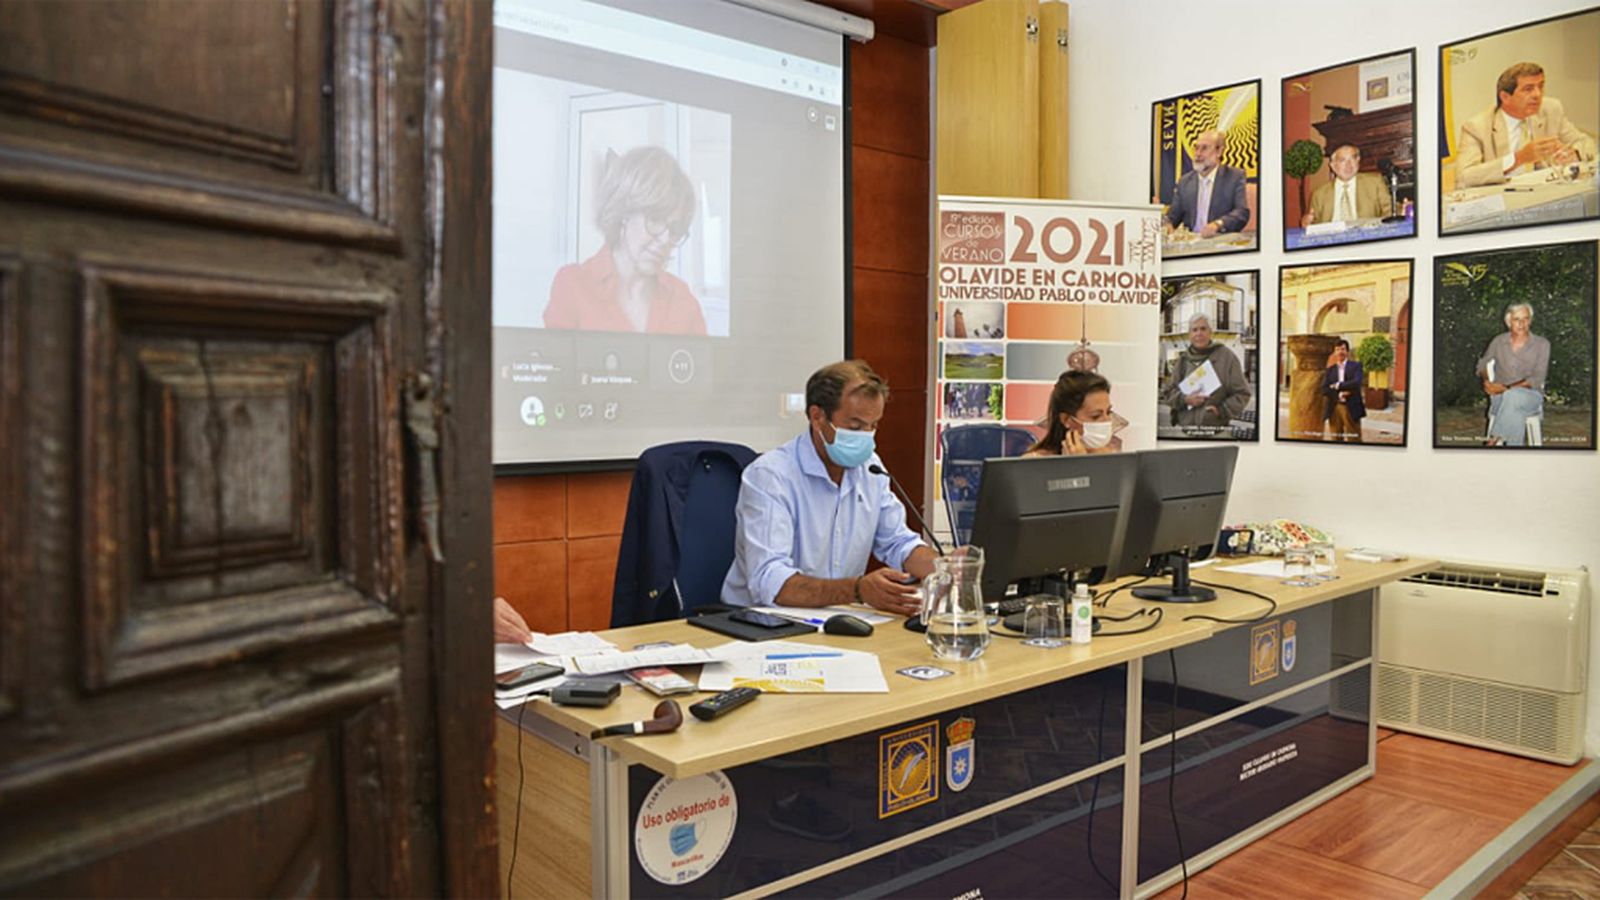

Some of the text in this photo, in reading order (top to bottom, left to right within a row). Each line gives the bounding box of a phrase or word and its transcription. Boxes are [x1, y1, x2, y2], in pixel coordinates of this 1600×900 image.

[943, 223, 1002, 240] CURSOS
[1009, 215, 1125, 266] 2021
[941, 246, 1004, 263] VERANO
[939, 266, 1159, 290] OLAVIDE EN CARMONA
[939, 285, 1035, 301] UNIVERSIDAD
[1039, 287, 1086, 302] PABLO
[1099, 290, 1158, 305] OLAVIDE
[642, 794, 730, 829] Uso obligatorio de
